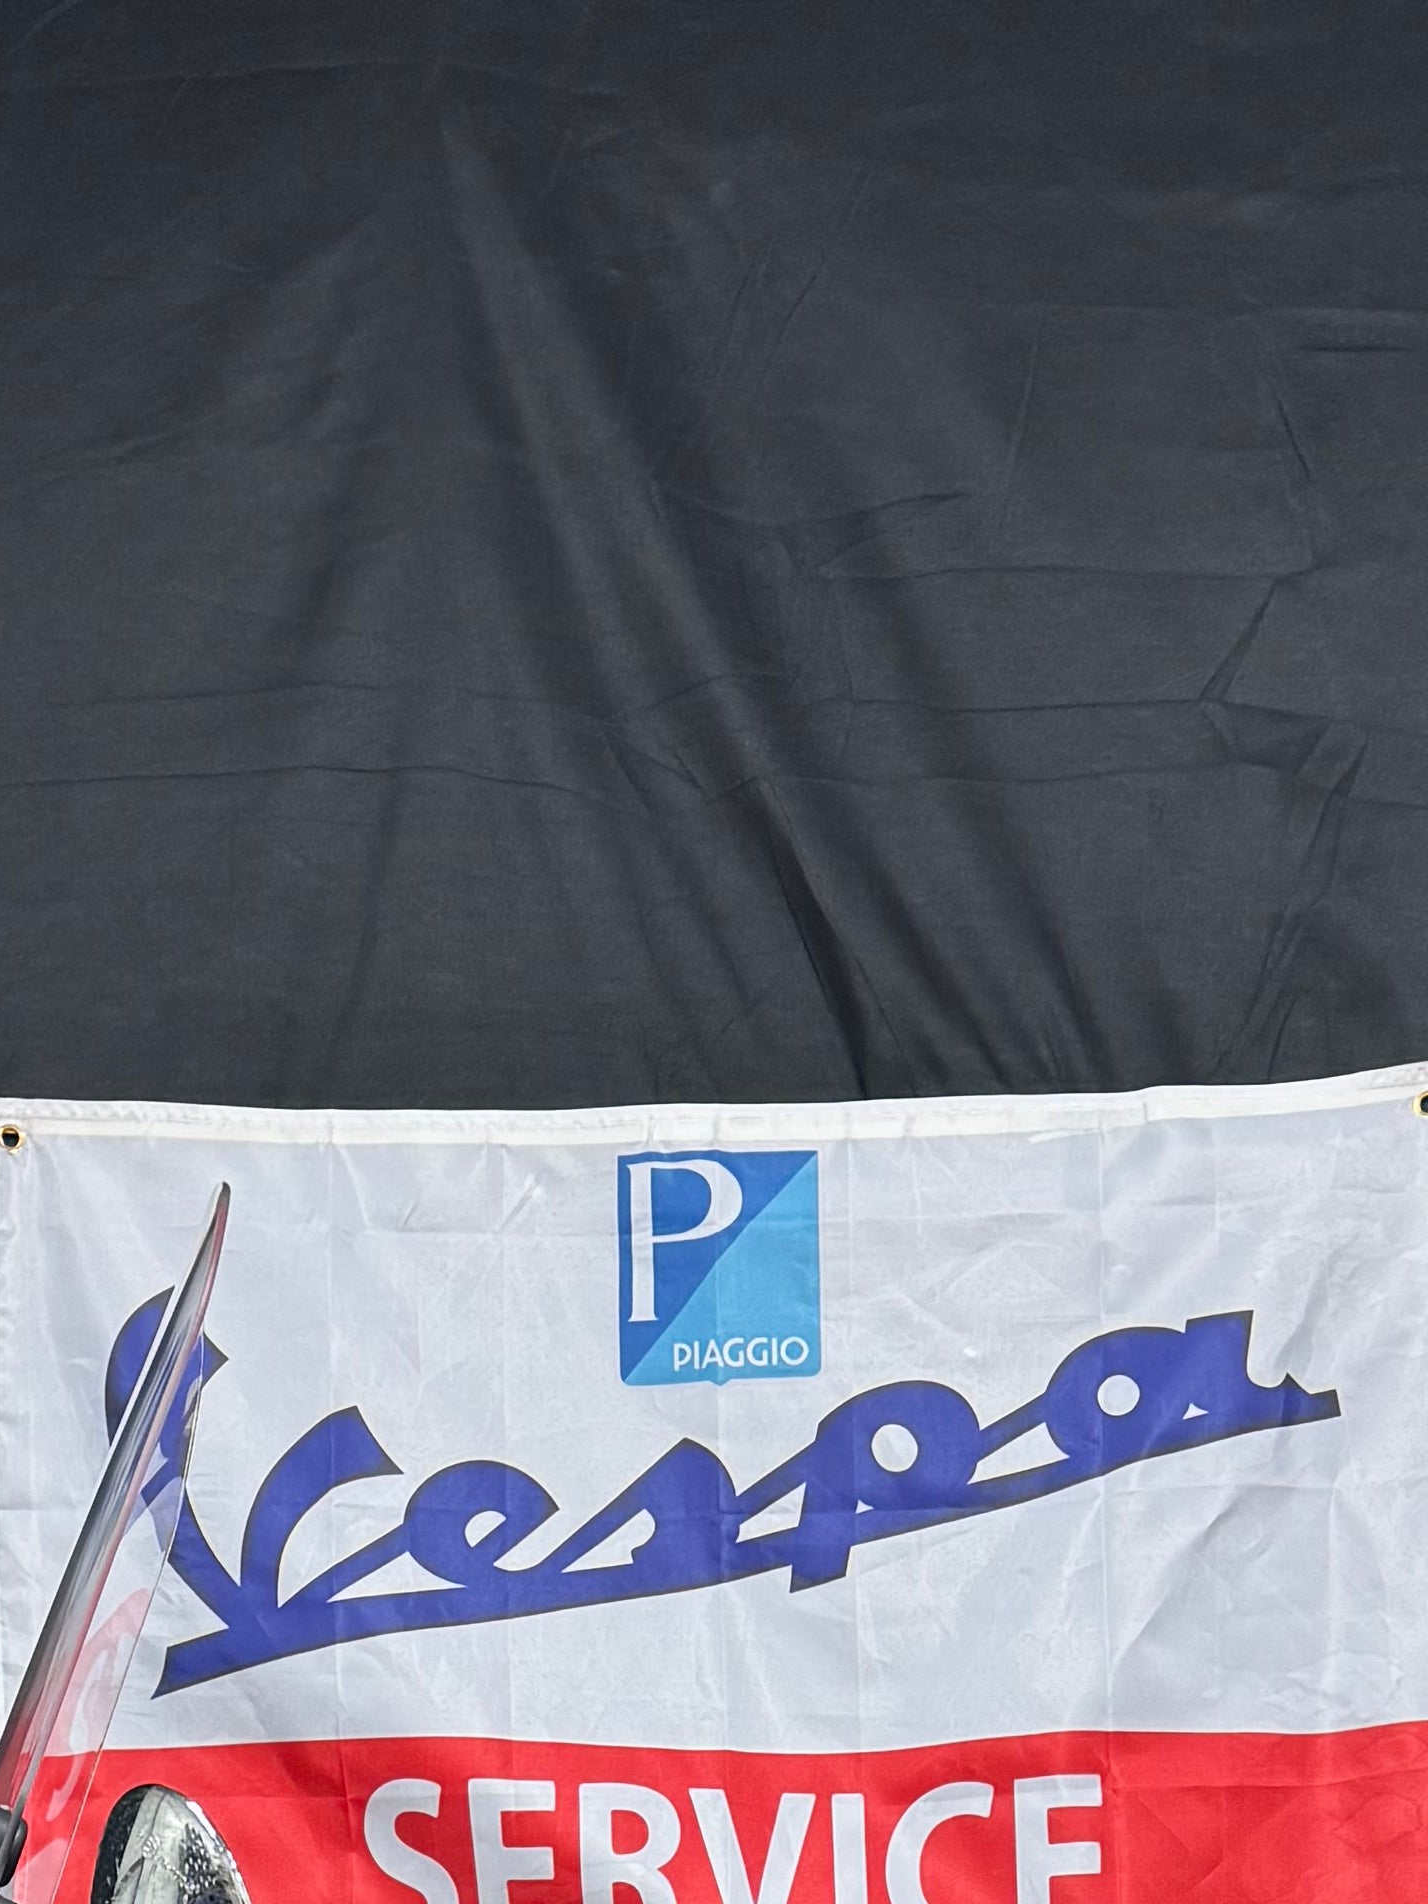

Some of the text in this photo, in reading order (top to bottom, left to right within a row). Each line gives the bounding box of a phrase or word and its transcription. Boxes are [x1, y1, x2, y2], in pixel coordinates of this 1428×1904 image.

[627, 1159, 743, 1323] P
[673, 1336, 810, 1372] PIAGGIO
[106, 1286, 1341, 1699] Vespa
